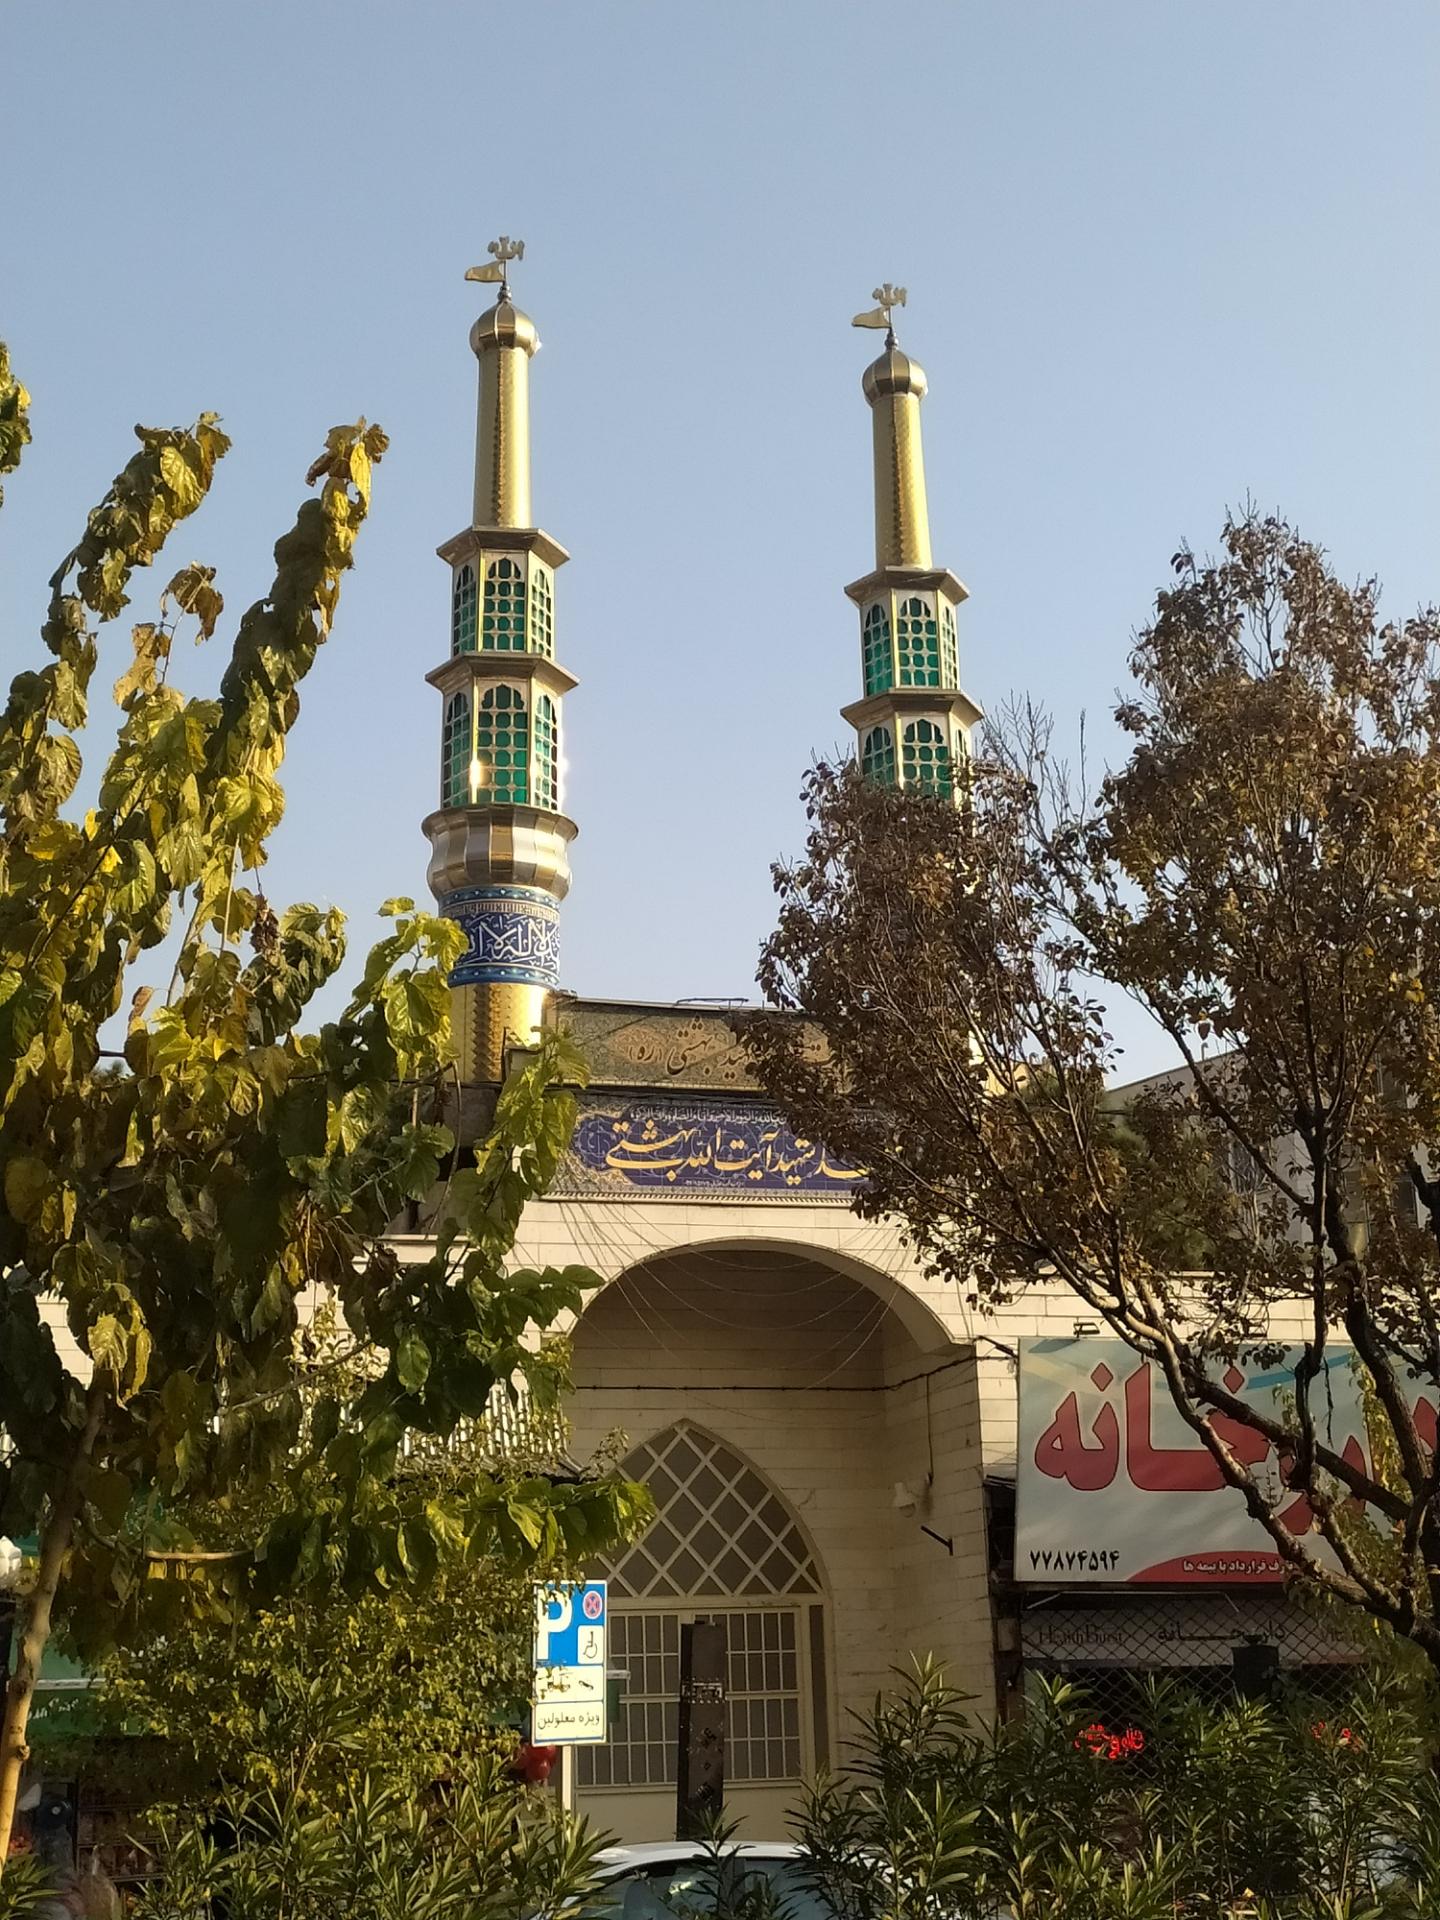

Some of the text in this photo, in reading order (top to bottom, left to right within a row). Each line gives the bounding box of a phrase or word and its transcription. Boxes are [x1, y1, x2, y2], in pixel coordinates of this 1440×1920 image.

[666, 1014, 714, 1076] بهشتی
[604, 1118, 697, 1182] بهشتی
[714, 1128, 780, 1181] آیت
[1034, 1361, 1440, 1536] روخانه
[1029, 1548, 1121, 1573] ۷۷۸۷۴۵۹۴
[1182, 1559, 1194, 1571] ها
[1196, 1561, 1216, 1575] بیمه
[1218, 1559, 1228, 1575] با
[1229, 1559, 1267, 1575] قرارداد
[536, 1588, 574, 1660] P
[537, 1711, 600, 1730] ویژه معلولین
